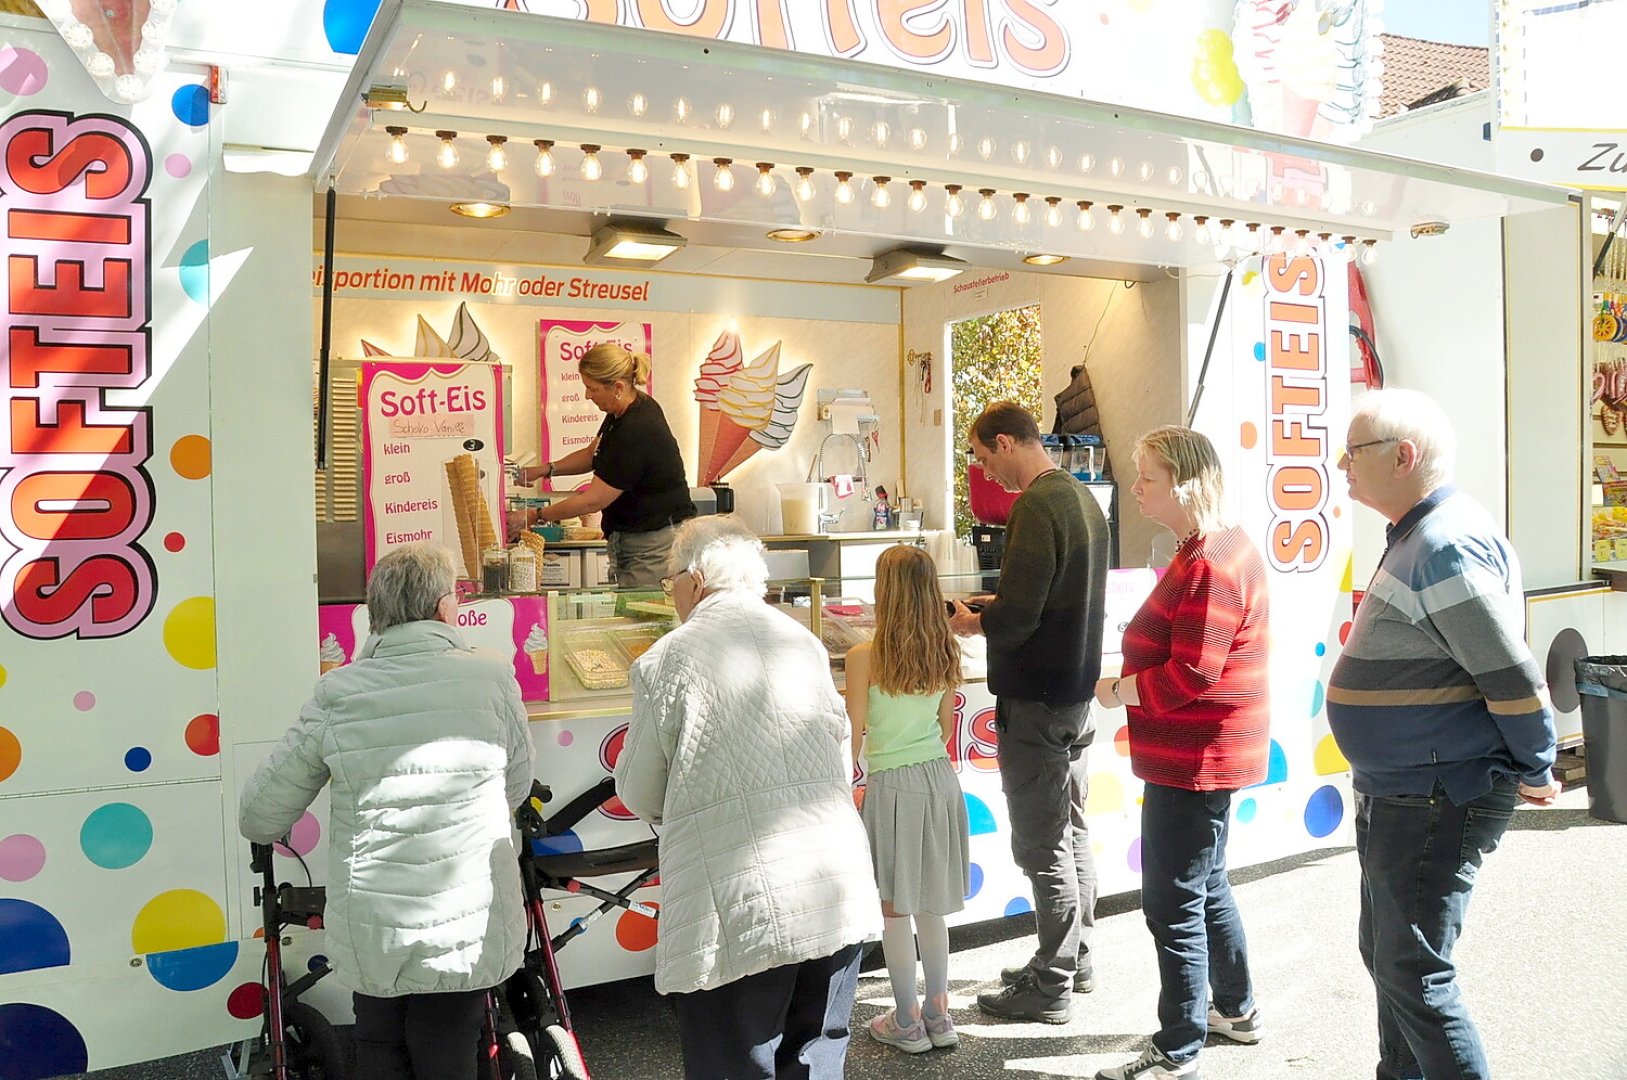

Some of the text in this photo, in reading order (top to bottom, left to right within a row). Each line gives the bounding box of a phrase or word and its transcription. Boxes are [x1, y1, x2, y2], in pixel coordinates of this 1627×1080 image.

[420, 270, 456, 292] mit
[460, 273, 516, 297] Mohr
[518, 276, 565, 297] oder
[568, 277, 649, 301] Streusel
[953, 271, 1009, 294] Schaustellerbetrieb
[4, 117, 151, 632] SOFTEIS
[561, 372, 580, 381] klein
[380, 385, 487, 418] Soft-Eis
[561, 393, 580, 403] groß
[1266, 249, 1328, 571] SOFTEIS
[562, 413, 599, 424] Kindereis
[383, 442, 411, 455] klein
[562, 435, 594, 446] Eismohr
[384, 471, 411, 485] groß
[385, 498, 438, 514] Kindereis
[386, 529, 433, 545] Eismohr
